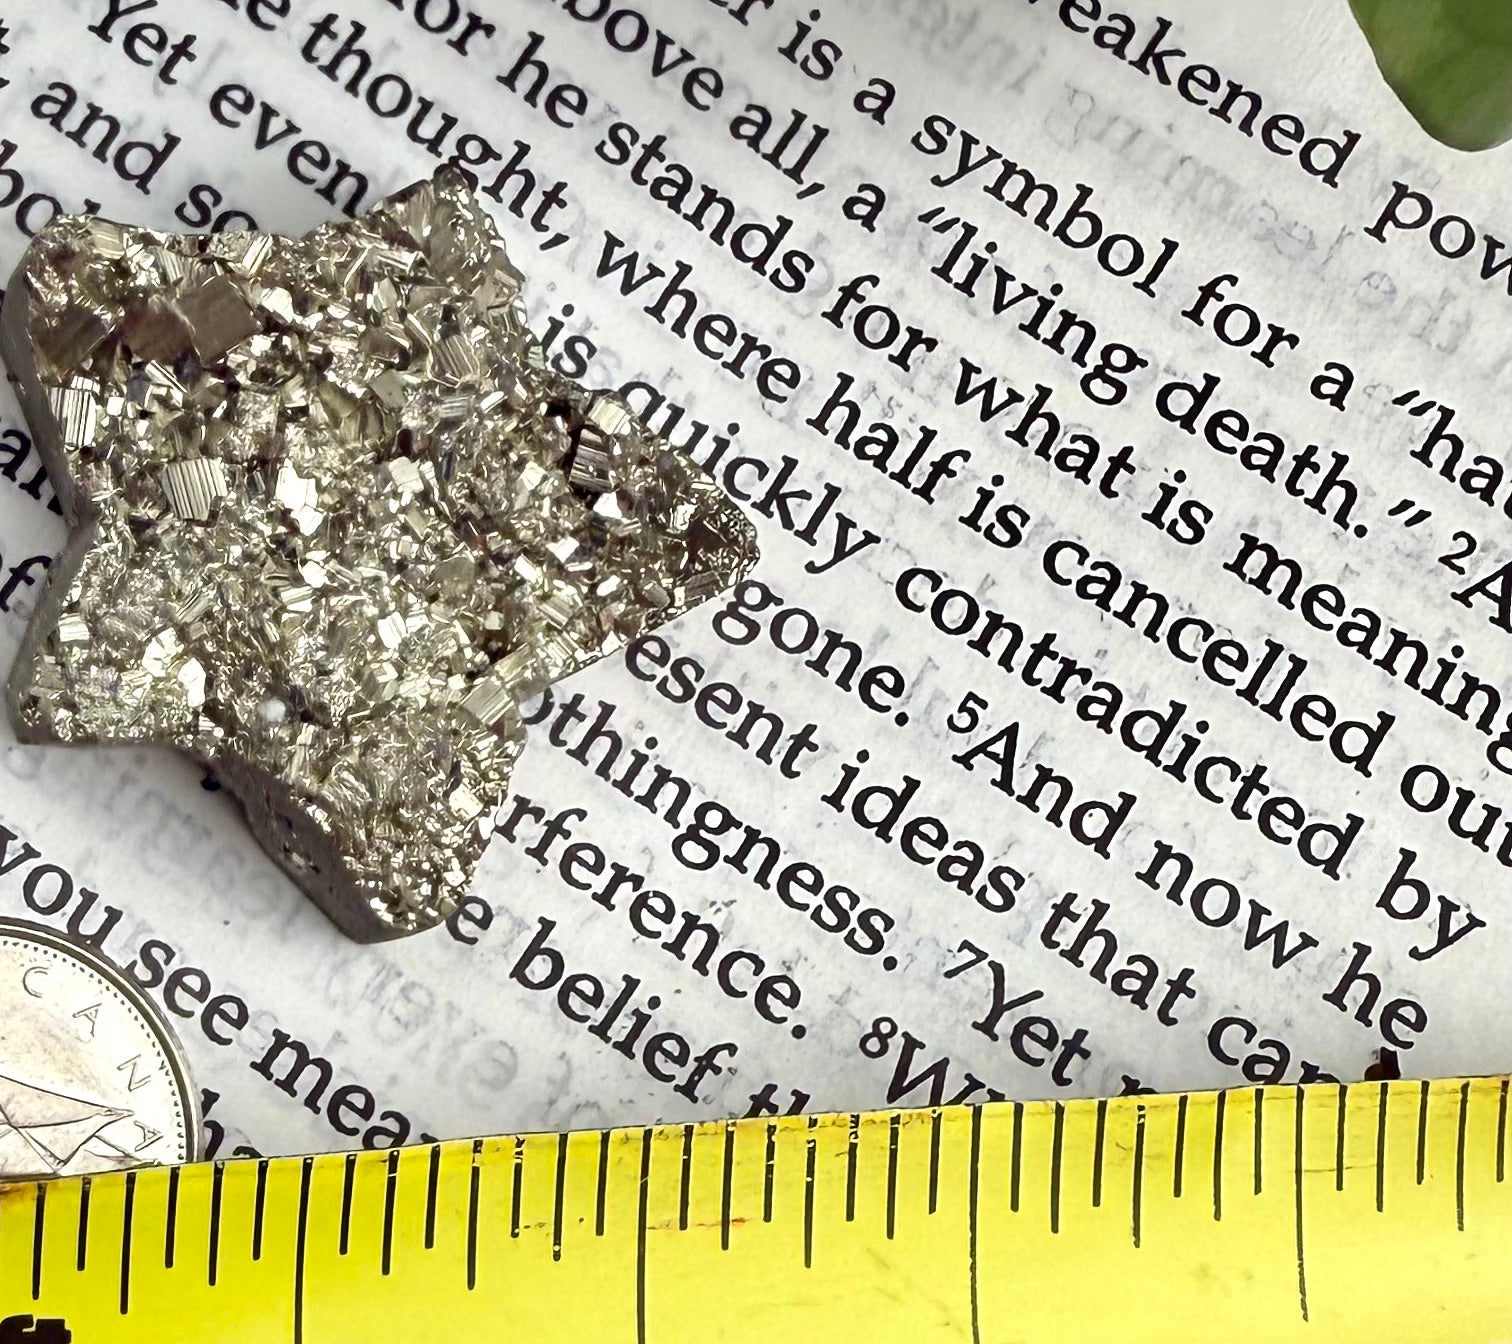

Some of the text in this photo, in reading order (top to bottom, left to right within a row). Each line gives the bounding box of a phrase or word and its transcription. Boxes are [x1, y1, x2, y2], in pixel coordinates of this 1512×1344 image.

[496, 31, 587, 128] he
[595, 122, 814, 293] stands
[821, 275, 938, 372] for
[955, 357, 1136, 498] what
[1141, 470, 1213, 545] is
[730, 104, 829, 199] all,
[842, 184, 885, 233] a
[778, 10, 842, 80] is
[854, 78, 895, 125] a
[911, 115, 1179, 298] symbol
[1181, 274, 1299, 368] for
[1310, 362, 1354, 411] a
[31, 82, 181, 195] and
[711, 578, 912, 728] gone.
[1135, 840, 1319, 969] now
[1322, 942, 1427, 1049] he
[597, 231, 800, 403] where
[806, 372, 971, 505] half
[959, 475, 1030, 548] is
[1043, 541, 1395, 778] cancelled
[821, 749, 1025, 913] ideas
[1041, 892, 1196, 1026] that
[896, 568, 1364, 880] contradicted
[509, 917, 738, 1104] belief
